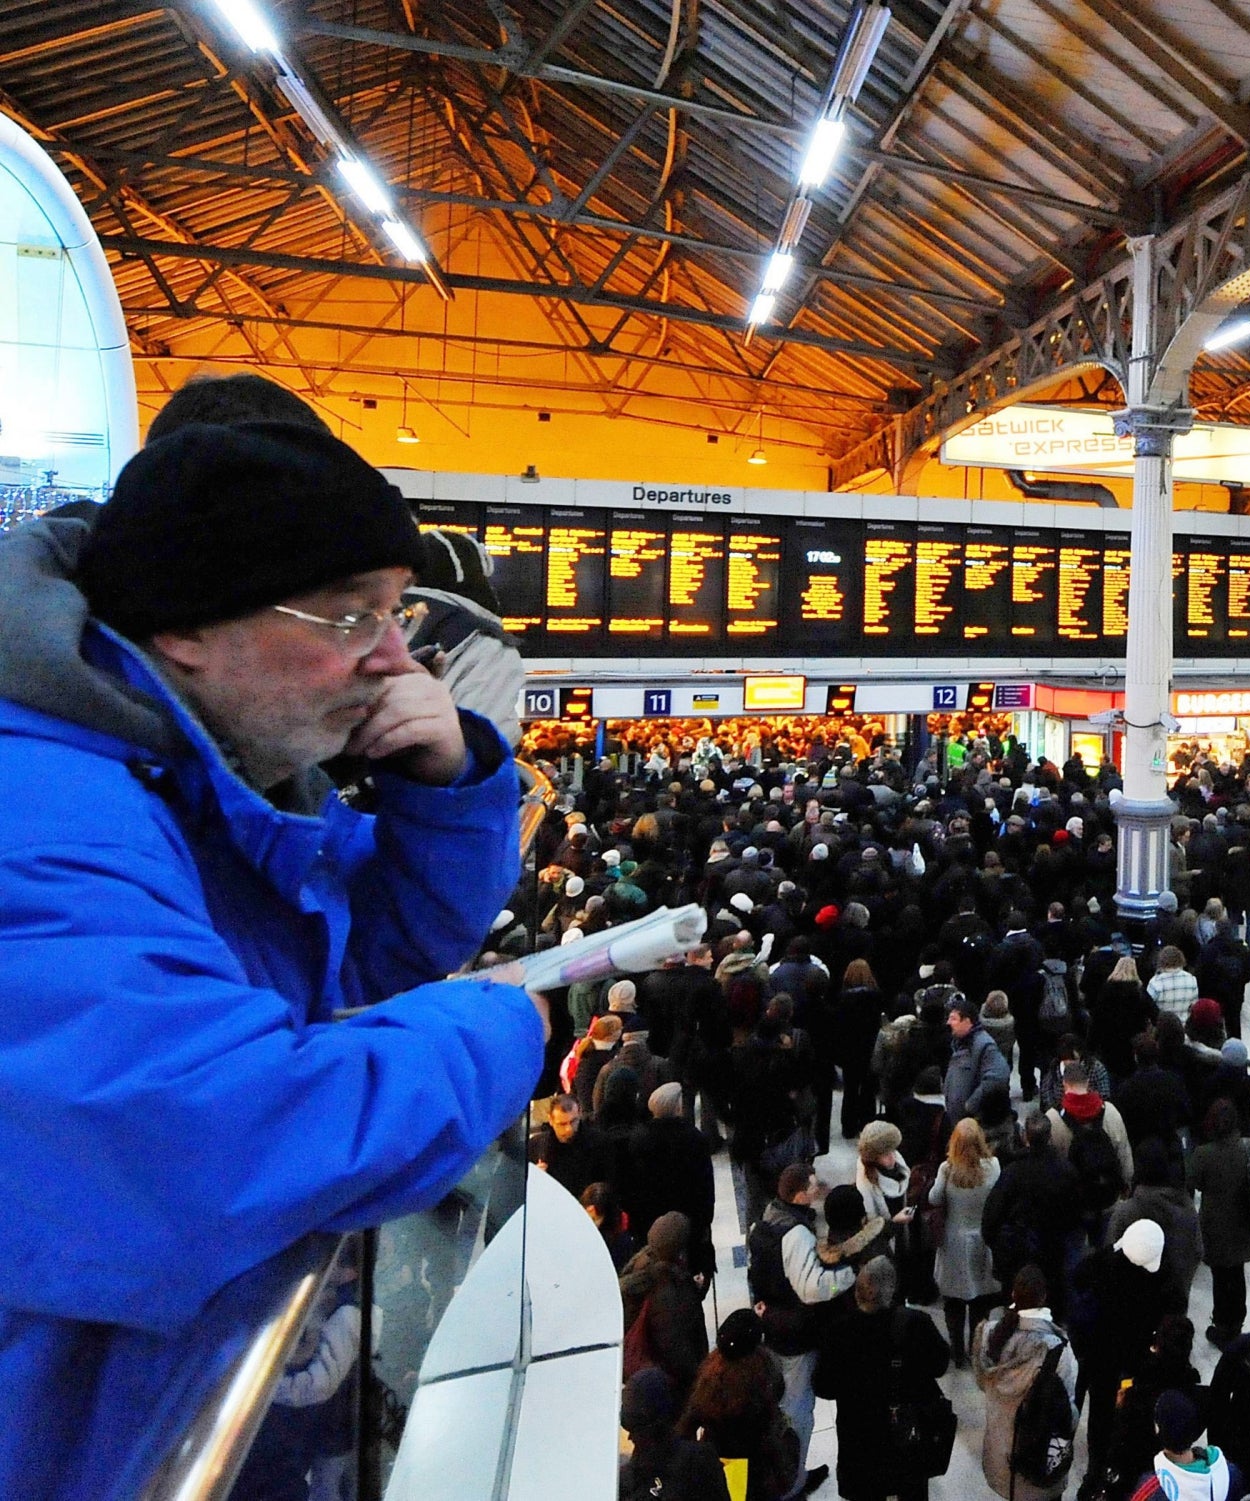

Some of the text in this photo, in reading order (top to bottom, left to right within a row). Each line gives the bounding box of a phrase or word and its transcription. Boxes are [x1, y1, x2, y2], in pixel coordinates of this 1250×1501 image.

[632, 486, 732, 505] Departures
[527, 694, 550, 712] 10
[649, 694, 666, 711] 11
[936, 688, 954, 705] 12
